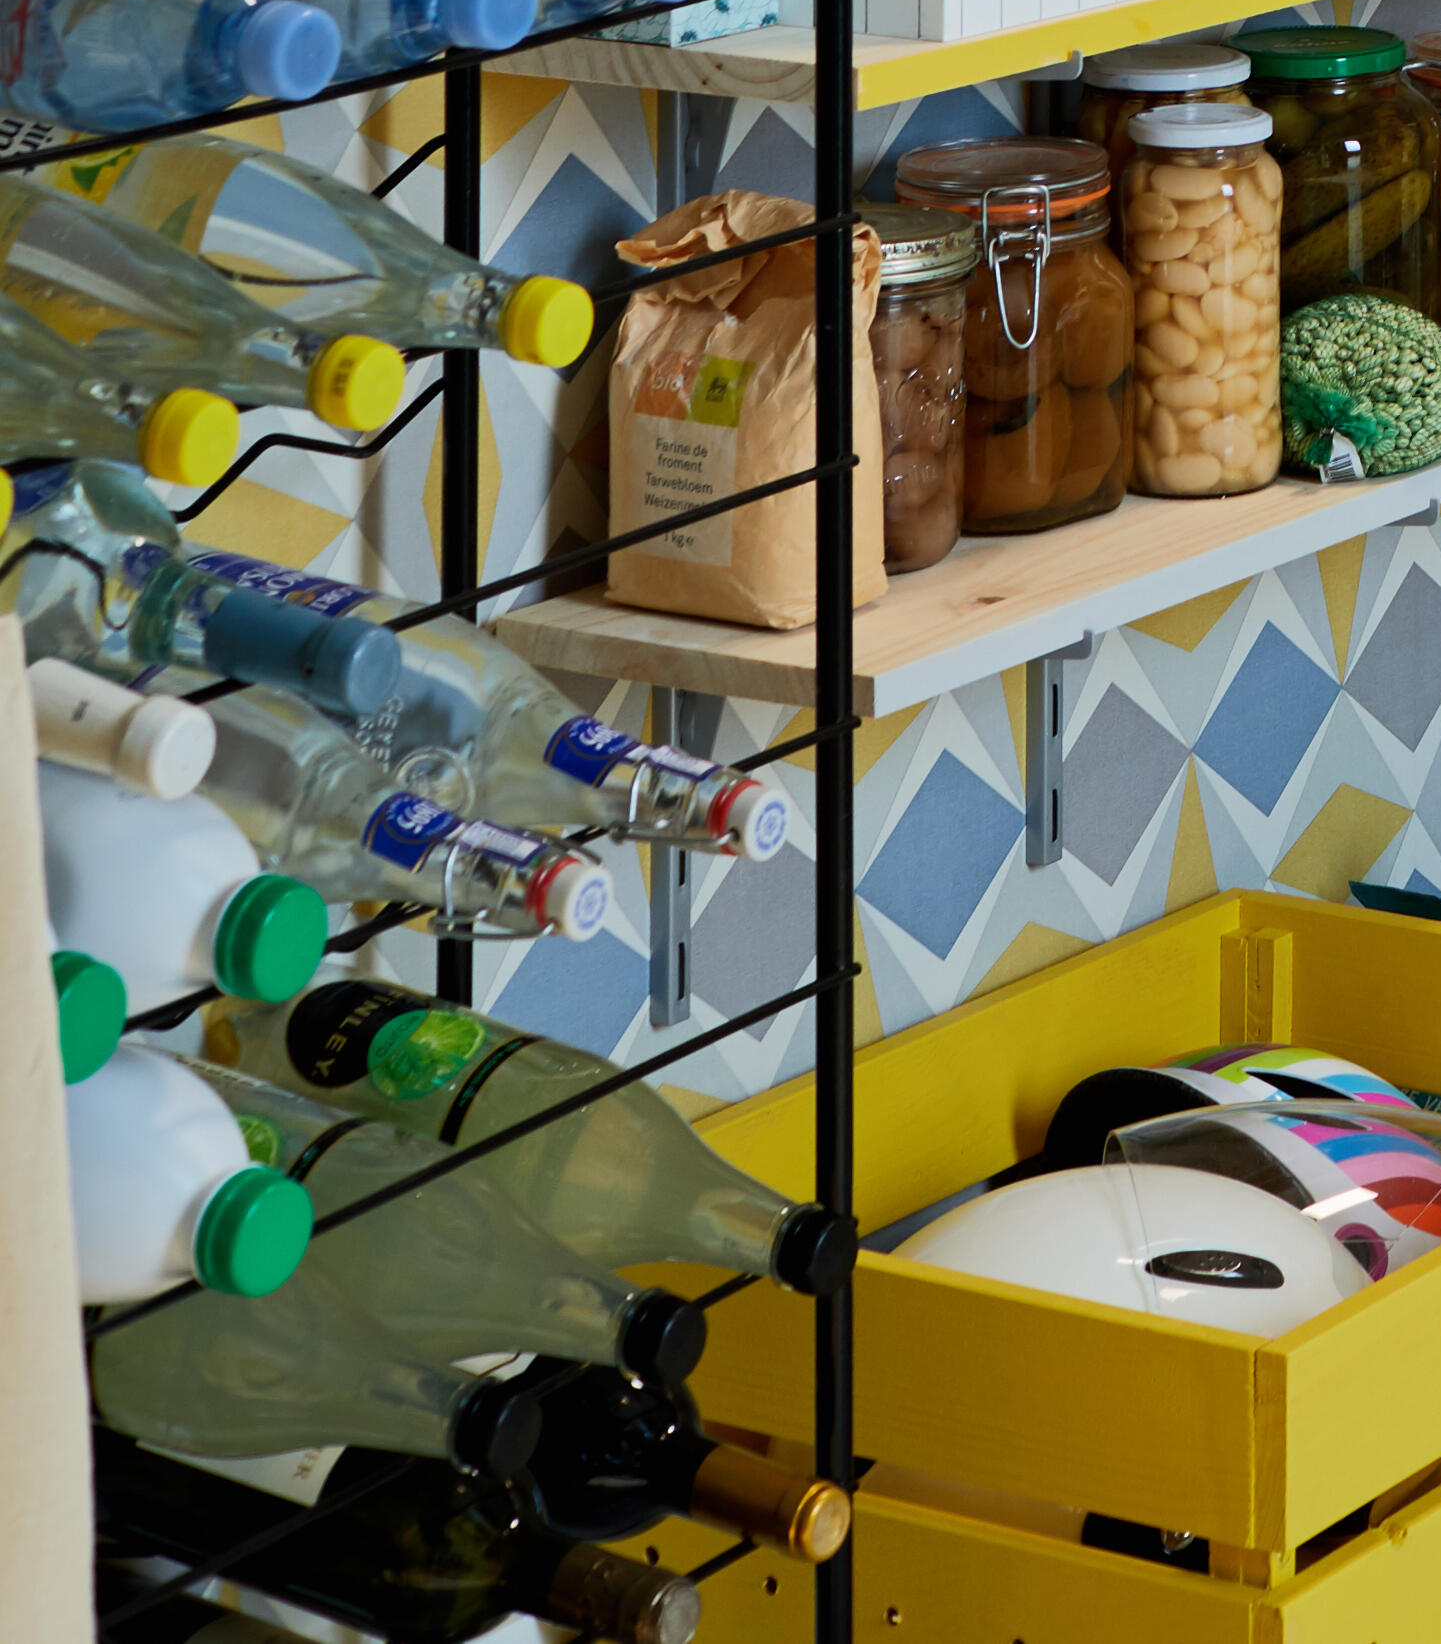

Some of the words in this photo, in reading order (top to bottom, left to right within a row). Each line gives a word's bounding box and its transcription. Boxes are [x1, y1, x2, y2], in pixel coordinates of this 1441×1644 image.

[655, 437, 692, 456] Farine
[693, 445, 709, 458] de
[657, 454, 703, 474] froment
[644, 472, 714, 495] Tarwebloem
